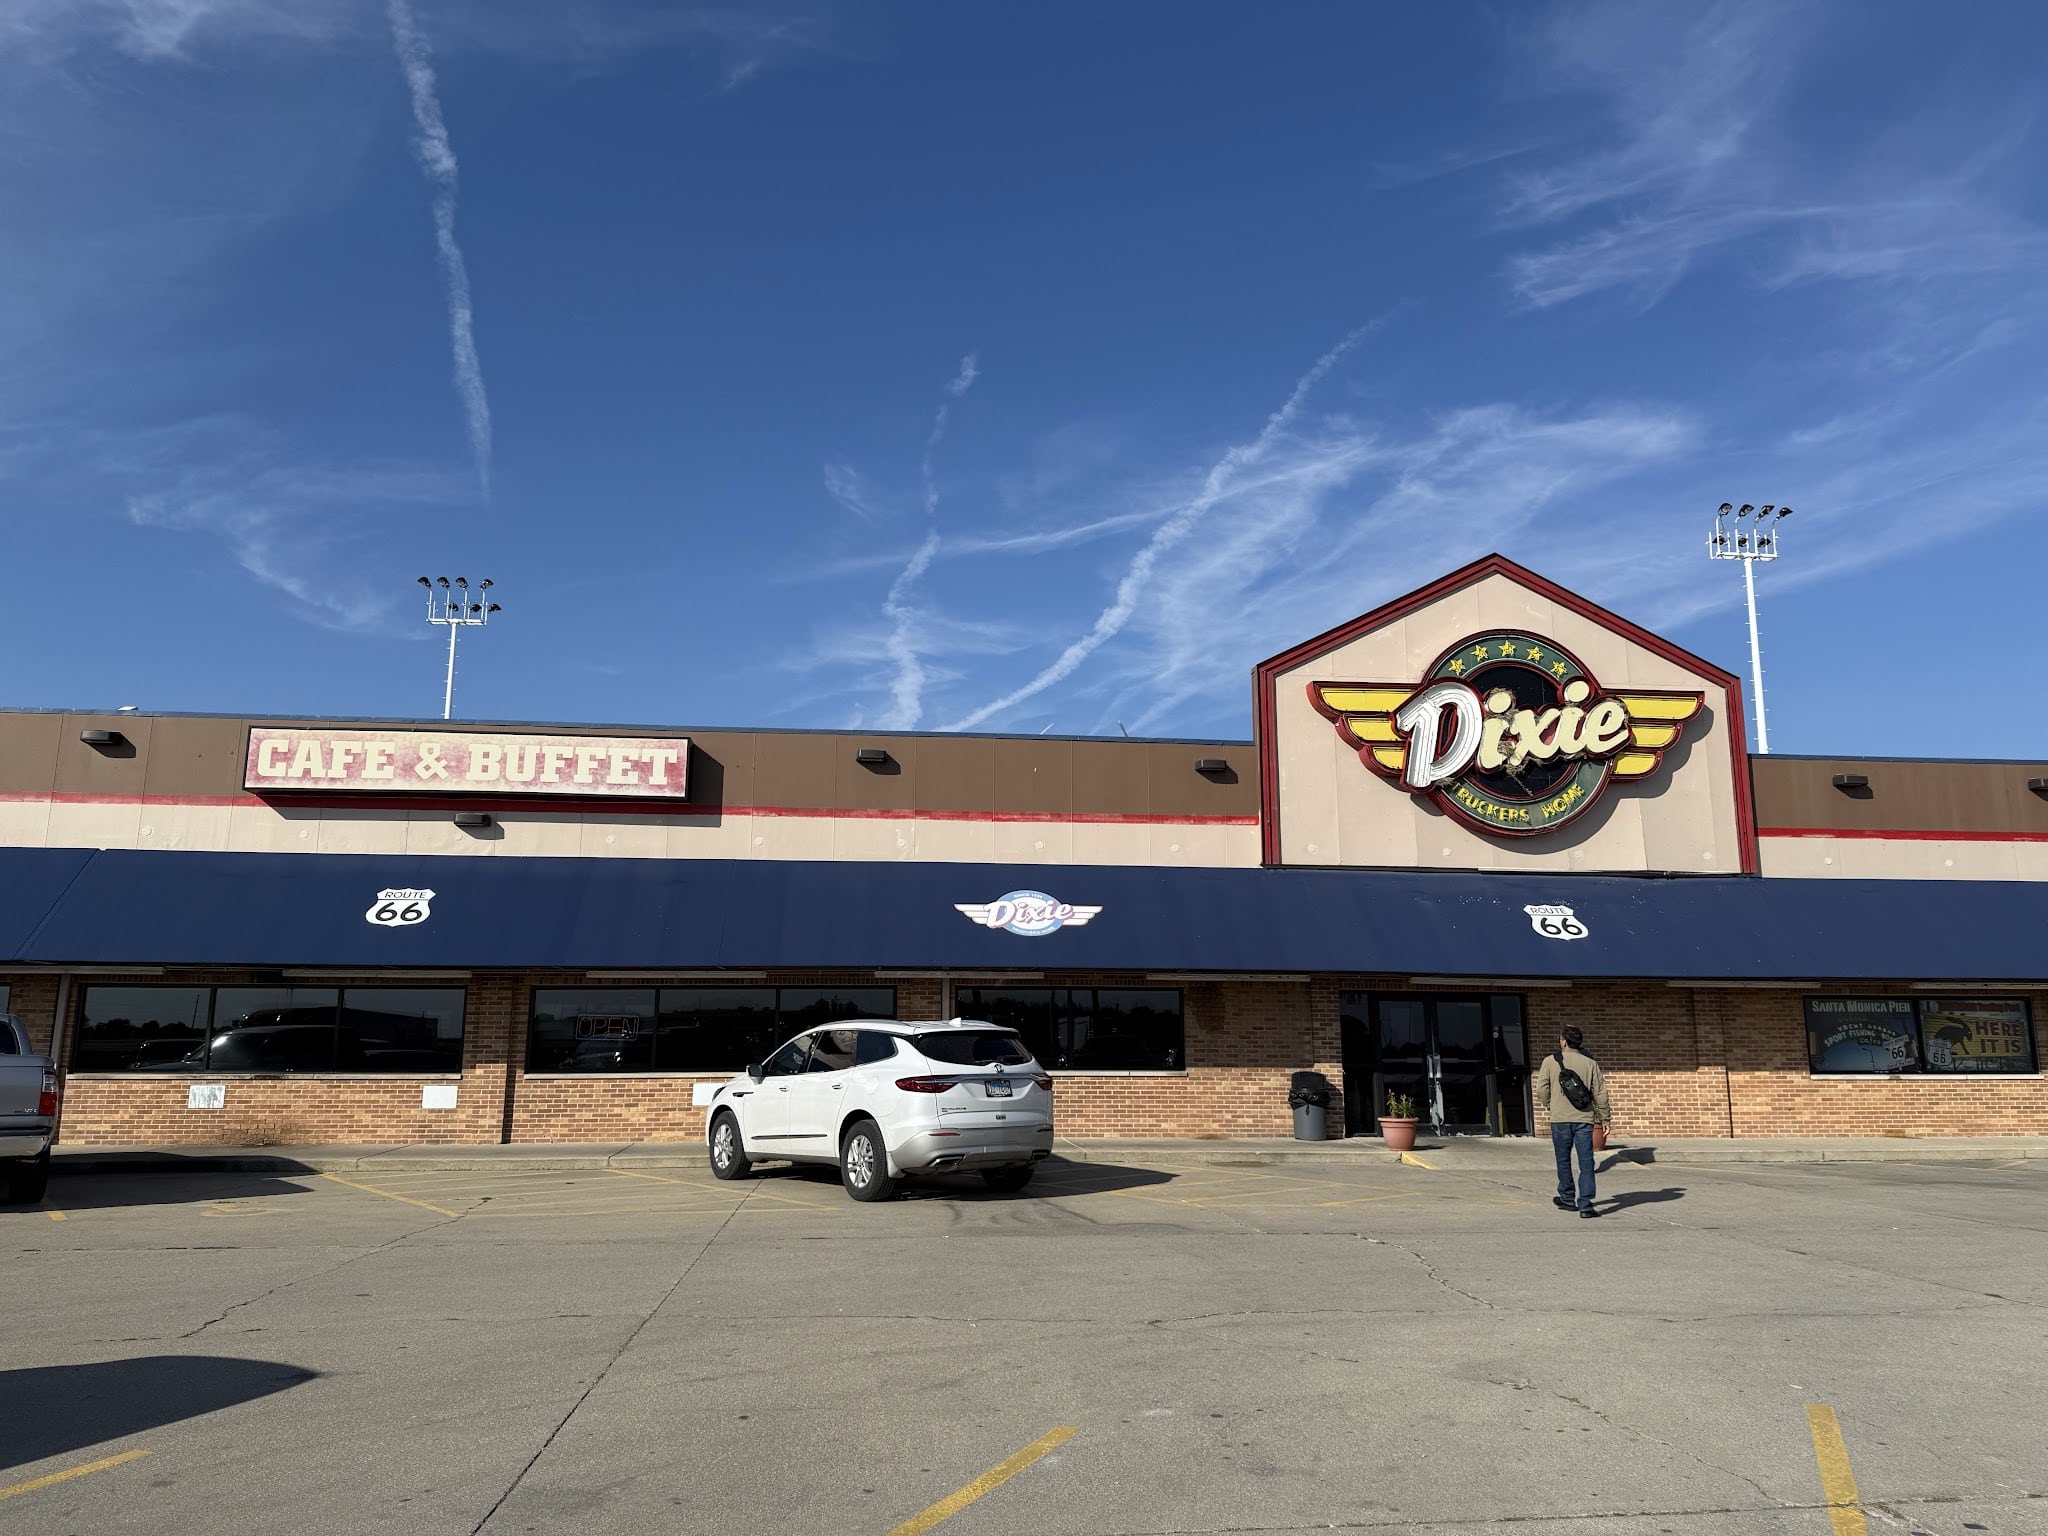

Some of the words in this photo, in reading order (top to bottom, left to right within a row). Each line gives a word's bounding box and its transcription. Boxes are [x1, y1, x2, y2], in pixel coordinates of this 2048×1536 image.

[1396, 681, 1629, 788] Dixie
[257, 738, 397, 780] CAFE
[413, 741, 449, 780] &
[466, 742, 678, 786] BUFFET
[1452, 782, 1530, 822] TRUCKERS
[1541, 783, 1585, 818] HOME
[384, 891, 428, 899] ROUTE
[375, 901, 423, 922] 66
[983, 900, 1075, 928] Dixie
[1529, 907, 1568, 915] ROUTE
[1540, 917, 1583, 936] 66
[1811, 1001, 1846, 1013] SANTA
[1846, 1001, 1888, 1013] MONICA
[1888, 1001, 1911, 1013] PIER
[578, 1016, 637, 1038] OPEN
[1975, 1020, 2021, 1037] HERE
[1824, 1031, 1847, 1047] SPORT
[1848, 1029, 1876, 1038] FISHING
[1980, 1039, 1999, 1053] IT
[2004, 1039, 2021, 1053] IS
[1891, 1046, 1904, 1059] 66
[1933, 1052, 1946, 1064] 66
